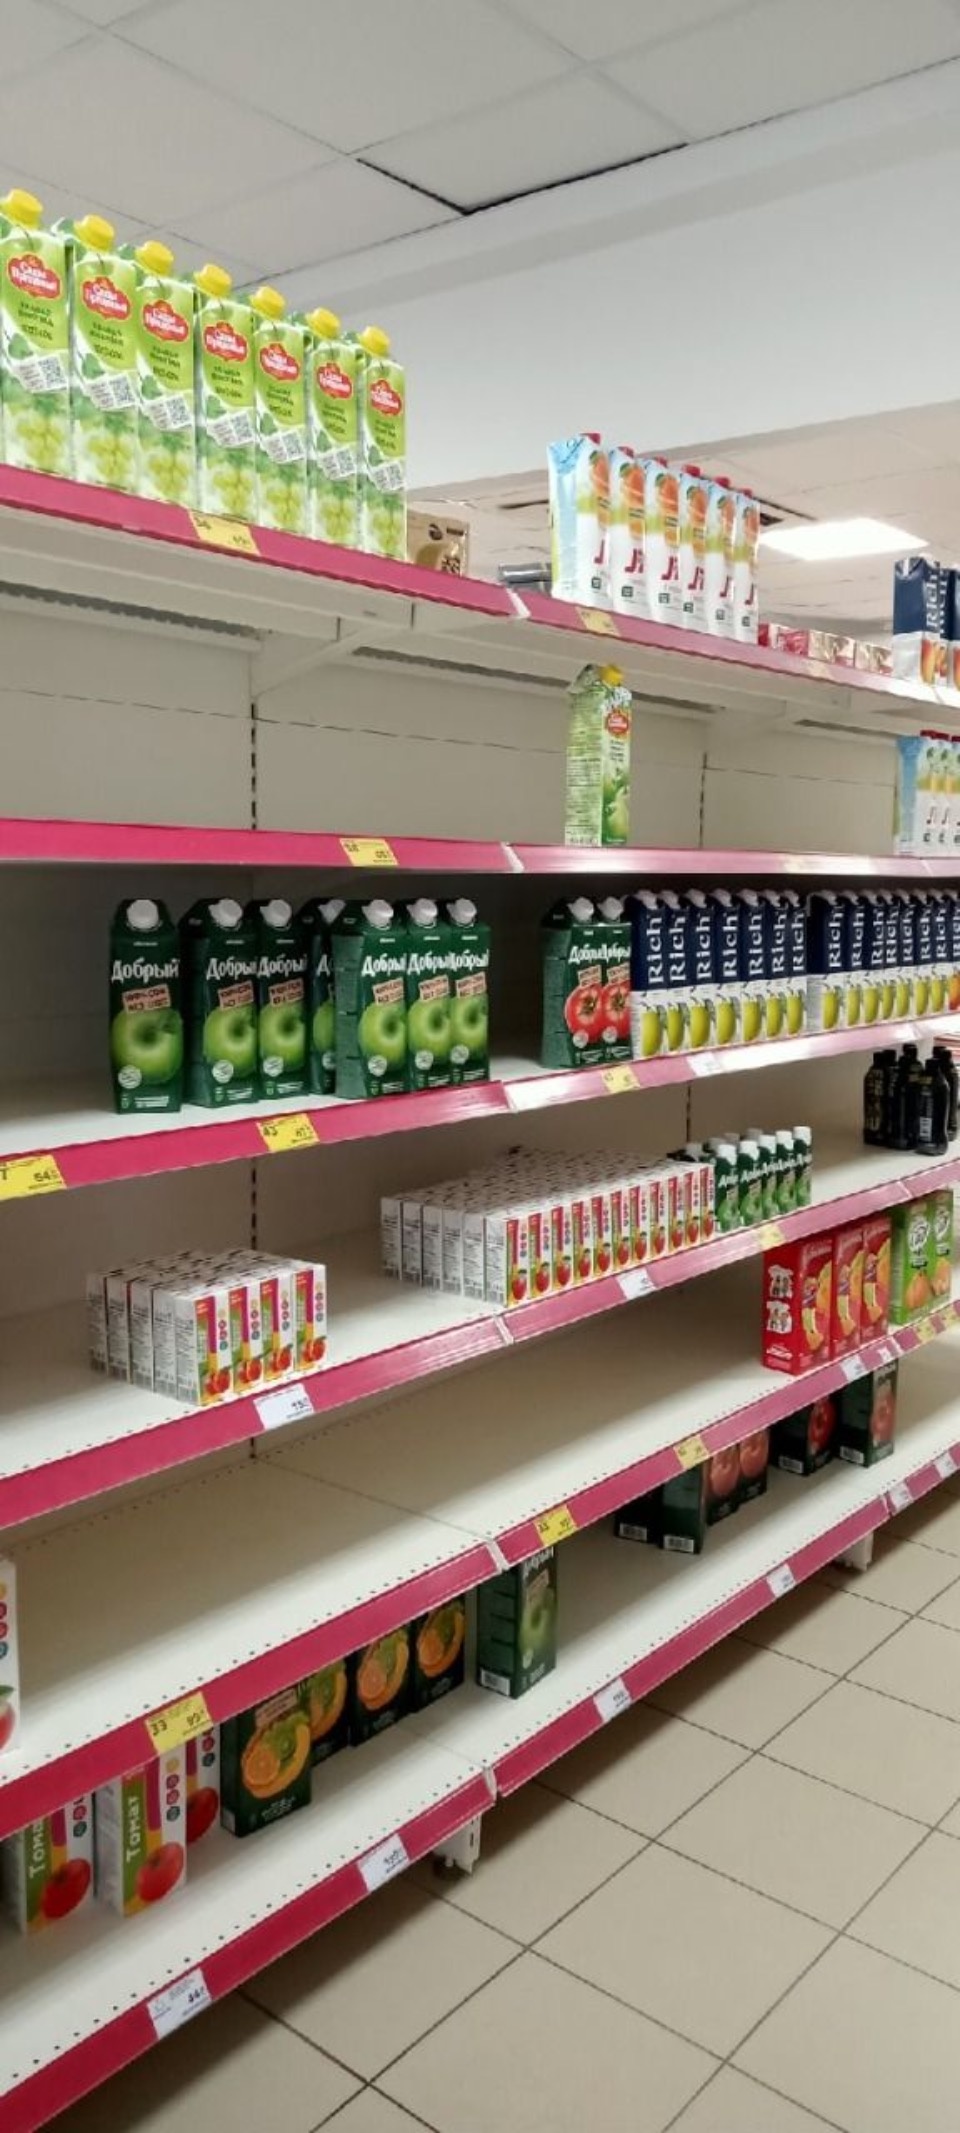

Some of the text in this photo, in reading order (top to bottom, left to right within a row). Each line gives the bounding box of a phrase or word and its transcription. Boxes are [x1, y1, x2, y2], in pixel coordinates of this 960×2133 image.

[647, 915, 664, 984] Rich
[669, 915, 686, 982] Rich
[695, 915, 712, 980] Rich
[722, 914, 738, 977] Rich
[748, 914, 763, 976] Rich
[772, 913, 786, 973] Rich
[791, 911, 805, 972] Rich
[828, 911, 843, 967] Rich
[852, 911, 864, 967] Rich
[871, 910, 883, 965] Rich
[886, 910, 899, 963] Rich
[902, 909, 914, 961] Rich
[920, 908, 931, 960] Rich
[936, 908, 946, 958] Rich
[111, 956, 180, 983] Добрый
[151, 1719, 167, 1736] 33
[30, 1819, 45, 1879] Тома
[126, 1796, 140, 1862] Томат
